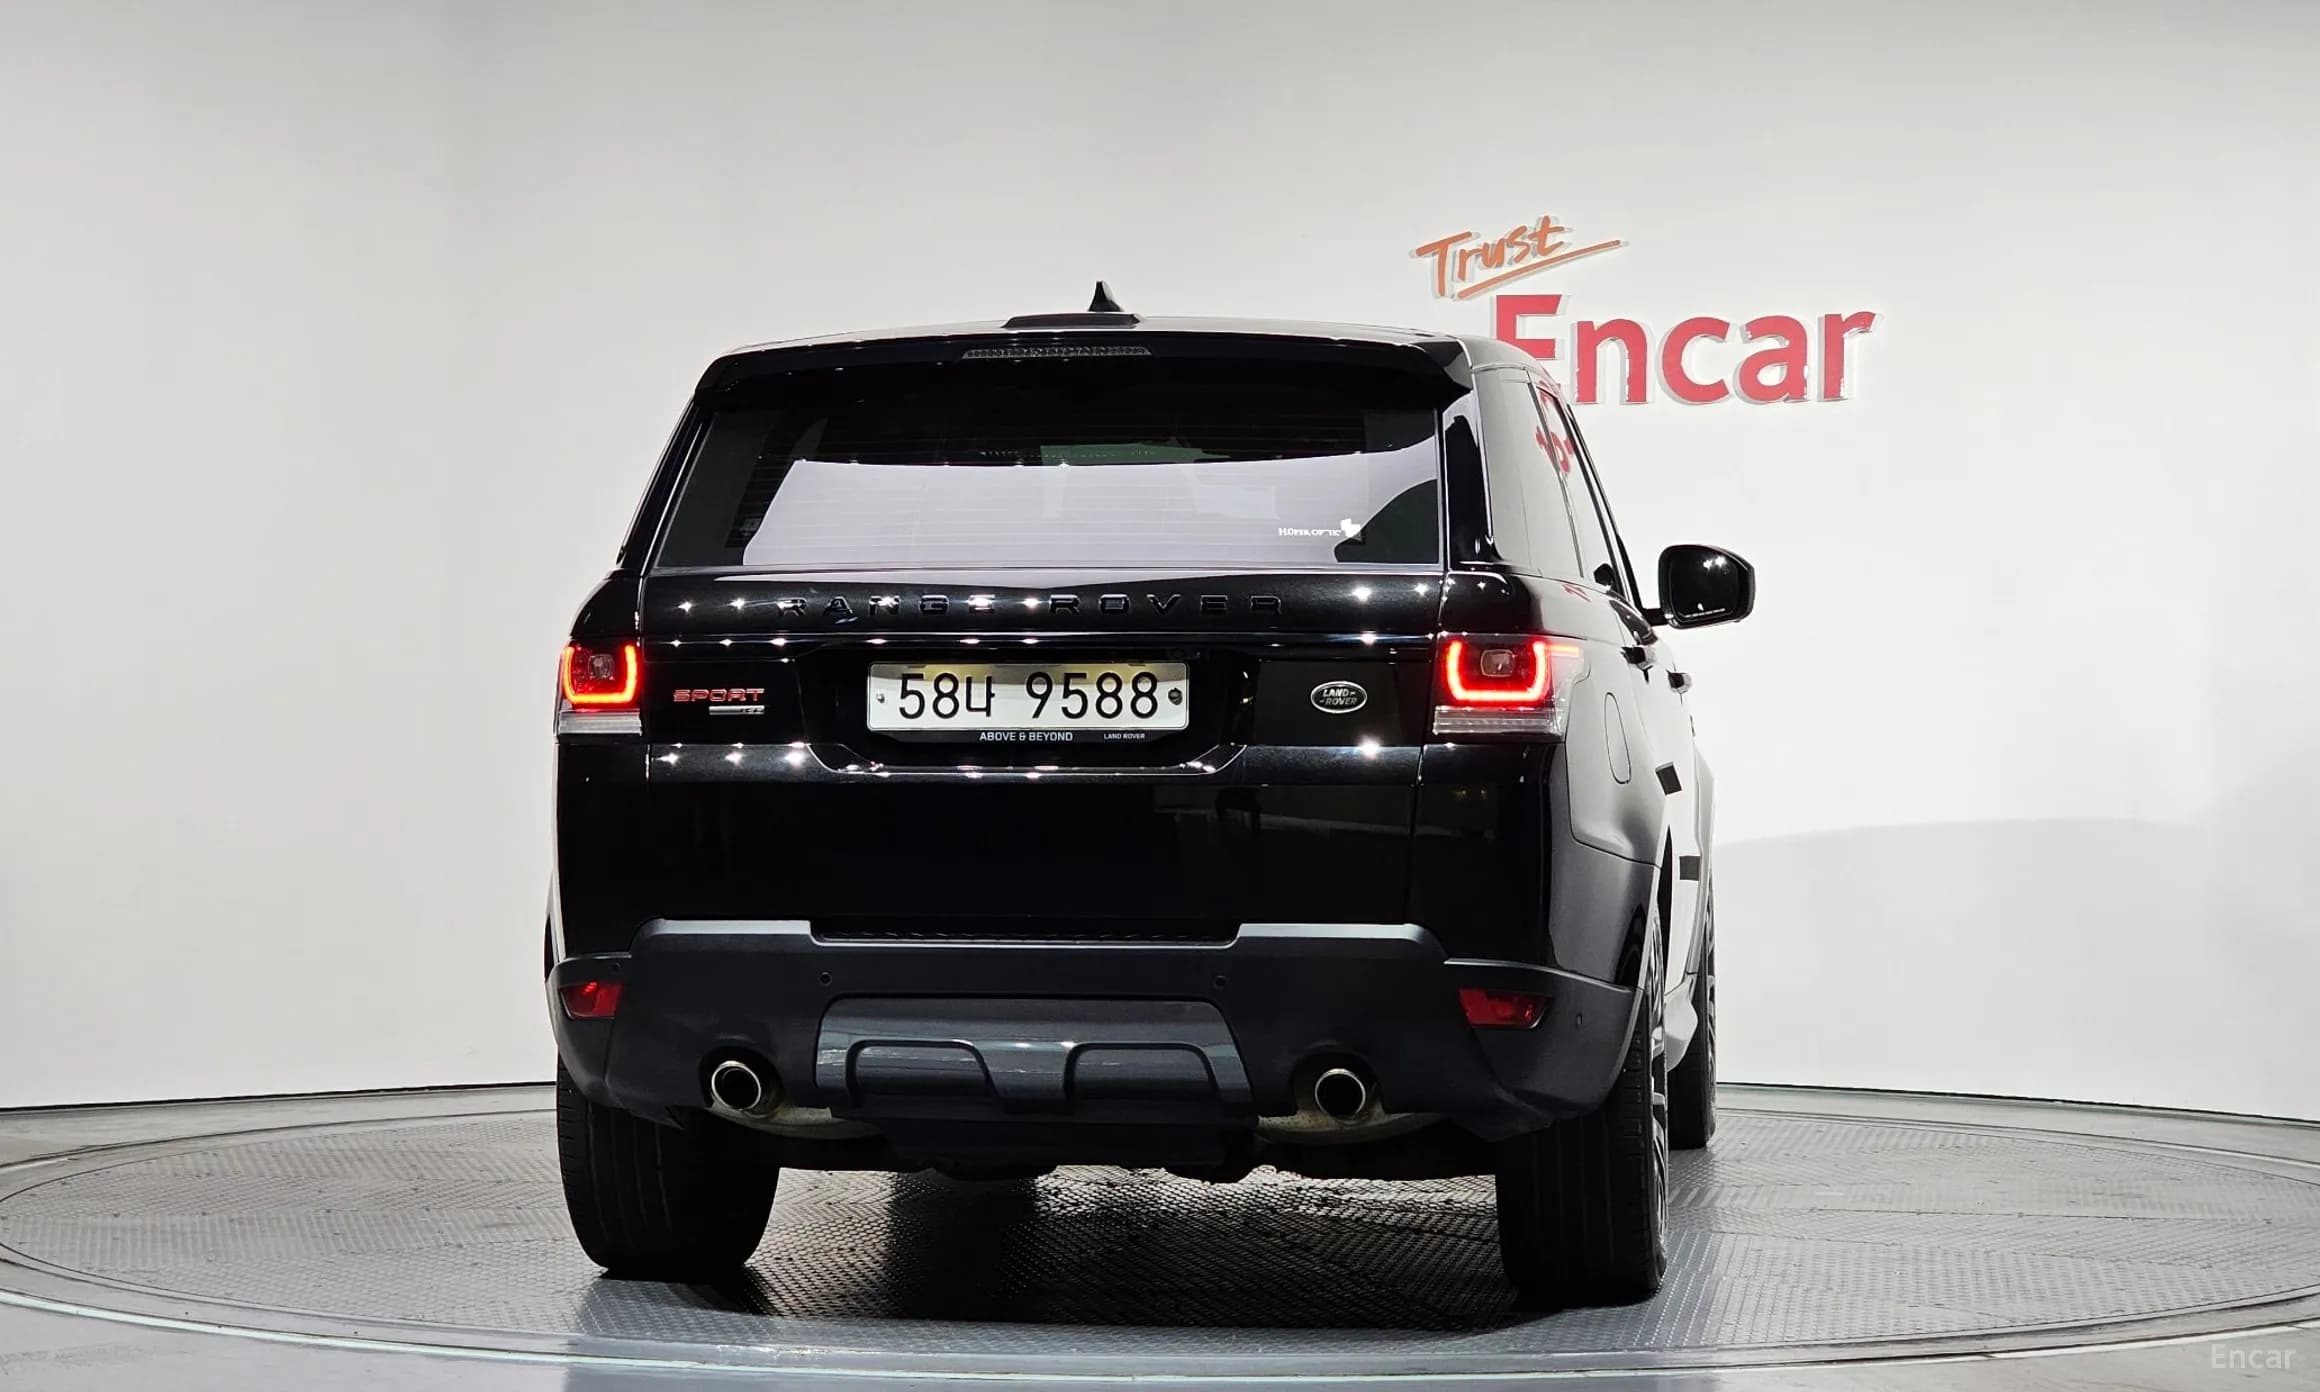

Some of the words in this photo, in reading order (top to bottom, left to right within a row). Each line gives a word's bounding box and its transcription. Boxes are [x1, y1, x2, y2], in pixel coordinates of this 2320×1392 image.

[1413, 215, 1566, 297] Trust
[1494, 293, 1877, 405] Encar
[776, 594, 996, 617] RANGE
[1048, 593, 1283, 616] ROVER
[672, 687, 766, 703] SPORT
[898, 671, 996, 720] 58나
[1025, 671, 1159, 720] 9588
[979, 731, 1017, 742] ABOVE
[1019, 731, 1026, 742] &
[1028, 731, 1074, 742] BEYOND
[1103, 732, 1122, 740] LAND
[1123, 732, 1146, 740] ROVER
